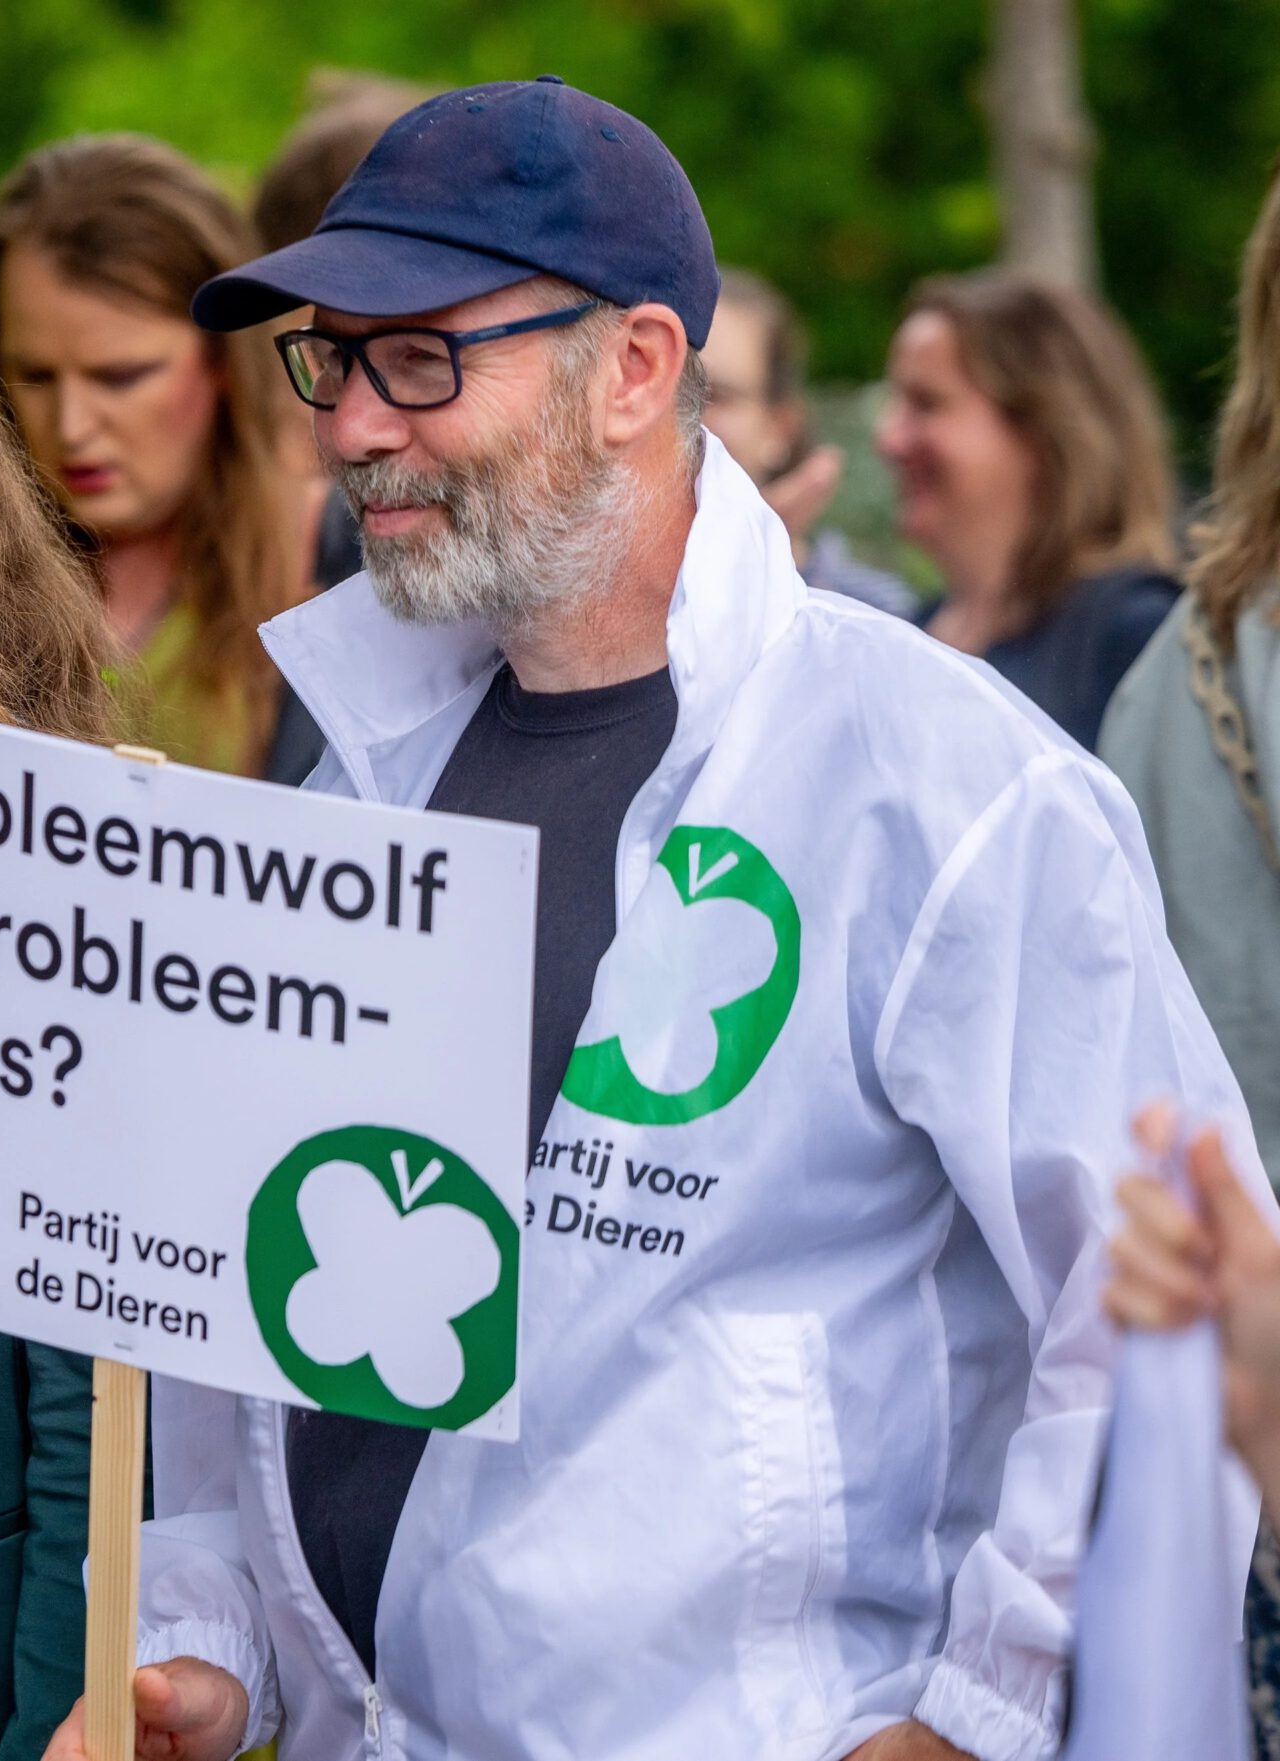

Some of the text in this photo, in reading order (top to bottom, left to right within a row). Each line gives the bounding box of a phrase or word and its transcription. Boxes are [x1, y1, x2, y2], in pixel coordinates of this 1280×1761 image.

[531, 1138, 719, 1200] artij voor
[20, 1191, 227, 1278] Partij voor
[546, 1192, 685, 1257] Dieren
[16, 1258, 209, 1341] de Dieren
